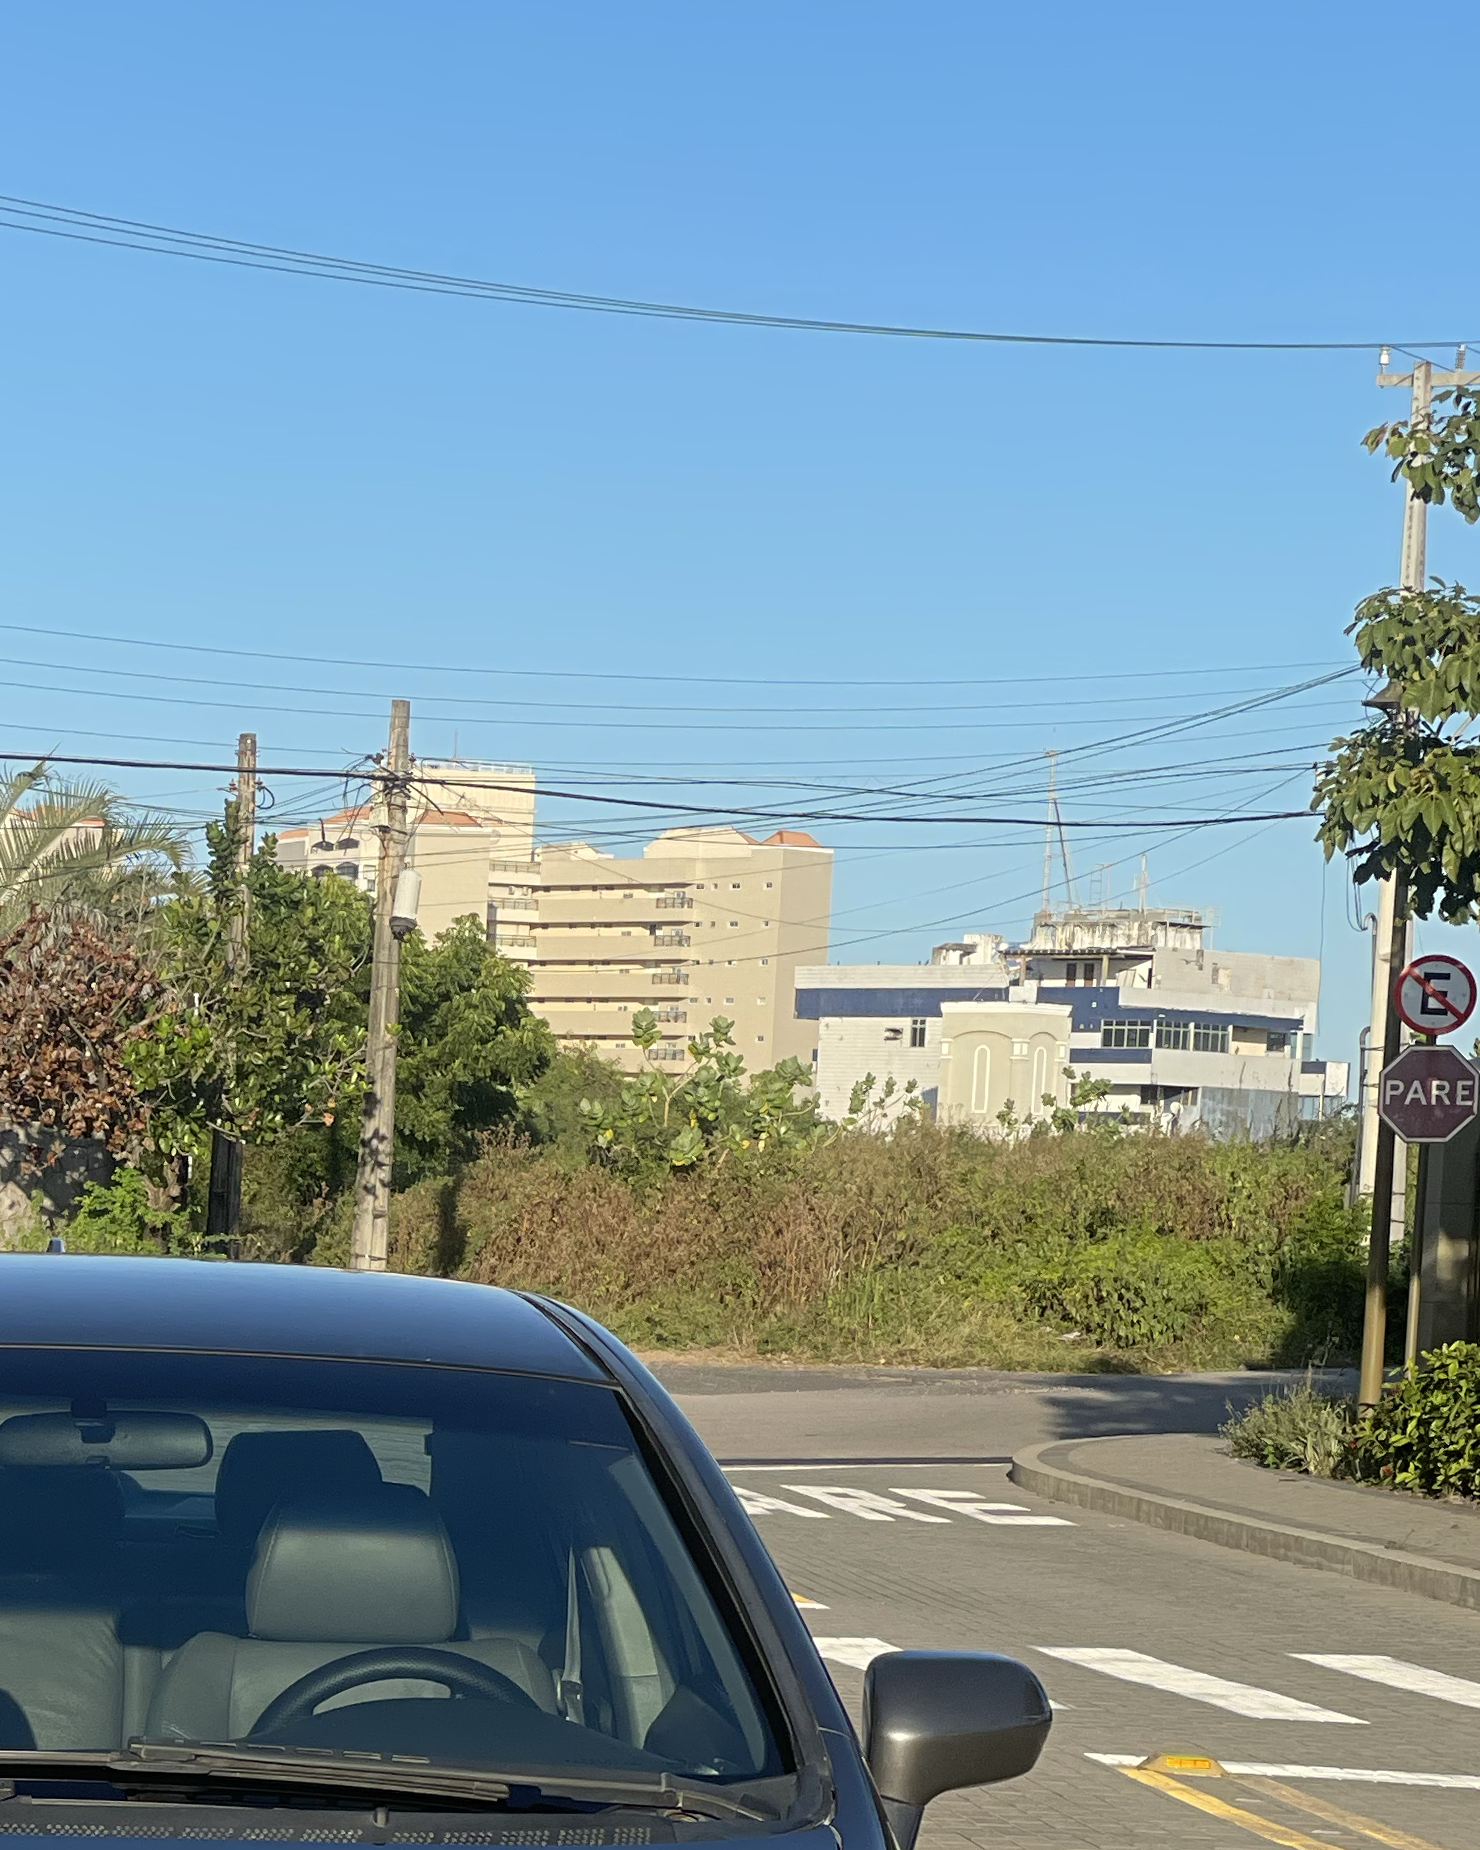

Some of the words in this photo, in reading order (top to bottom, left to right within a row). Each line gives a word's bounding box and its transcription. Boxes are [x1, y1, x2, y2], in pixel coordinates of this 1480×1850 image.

[1420, 972, 1451, 1016] E
[1384, 1080, 1474, 1106] PARE
[731, 1484, 1081, 1527] ARE
